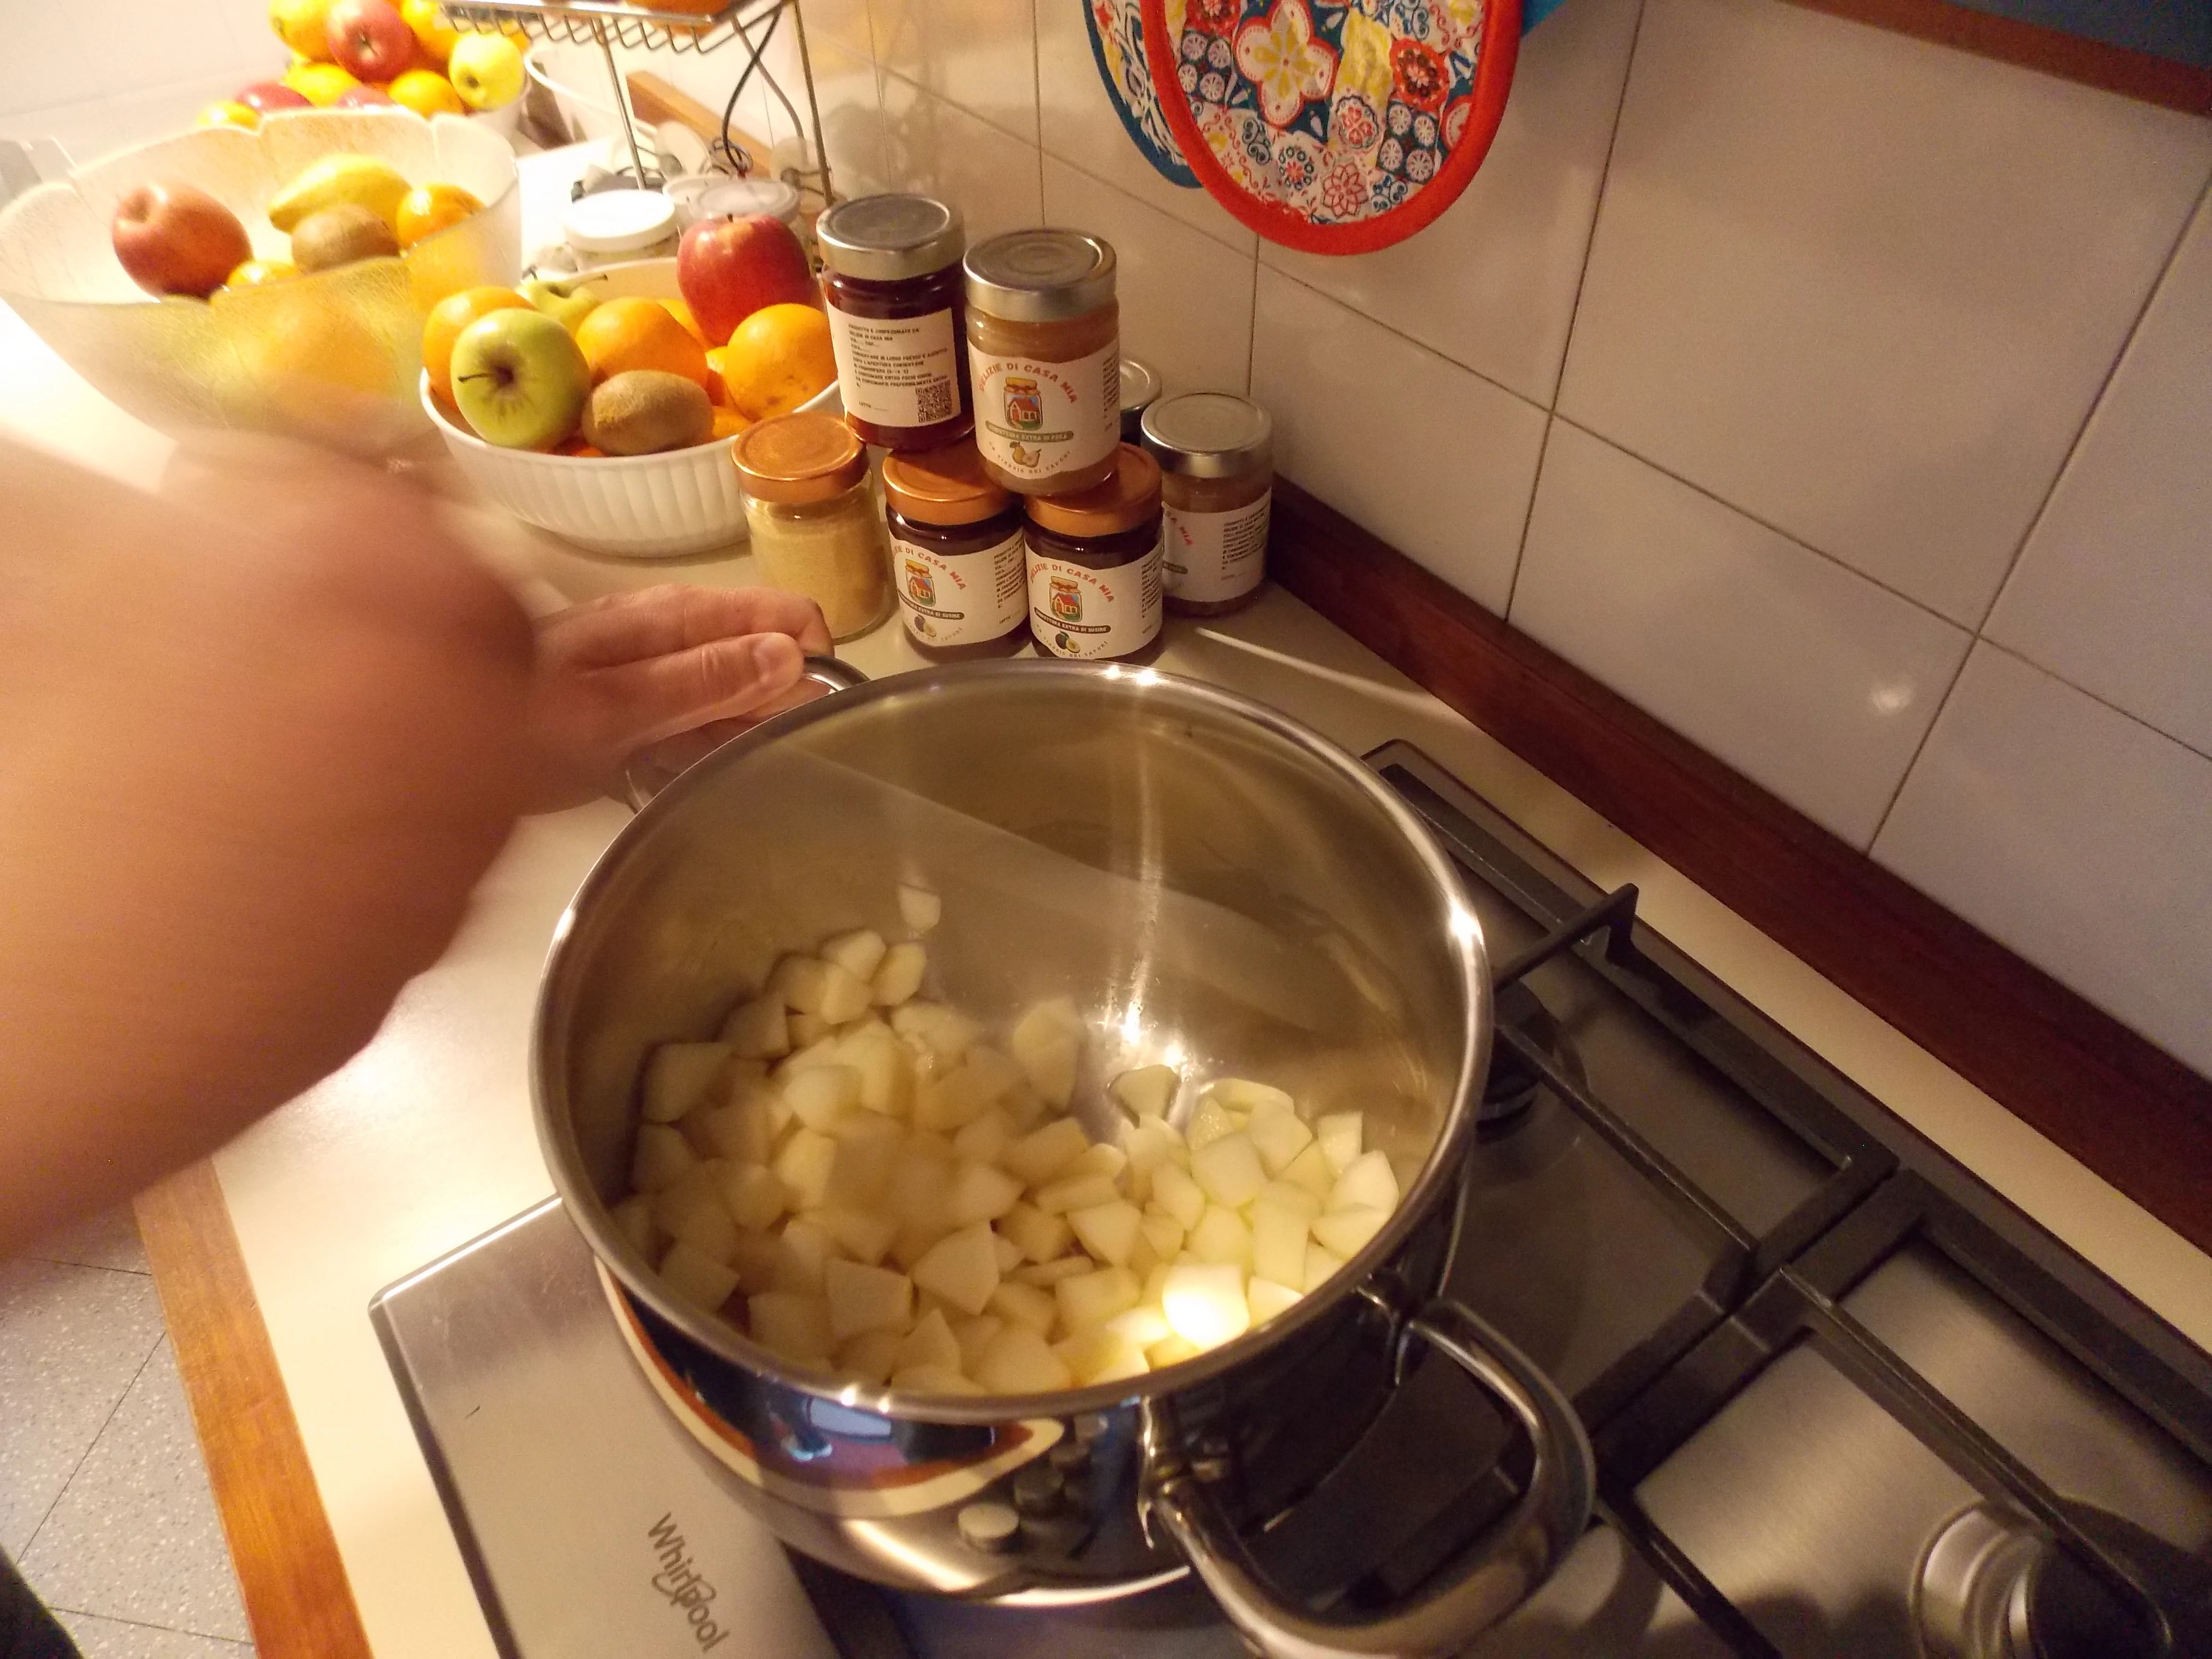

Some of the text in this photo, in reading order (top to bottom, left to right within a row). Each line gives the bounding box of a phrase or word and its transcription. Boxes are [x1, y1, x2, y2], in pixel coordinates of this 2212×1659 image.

[978, 362, 1078, 403] DELIZIE DI CASA MIA
[918, 552, 948, 571] CASA
[949, 570, 967, 590] MIA
[1067, 568, 1097, 585] CASA
[1098, 584, 1114, 602] MIA
[648, 1512, 732, 1653] Whirlpool
